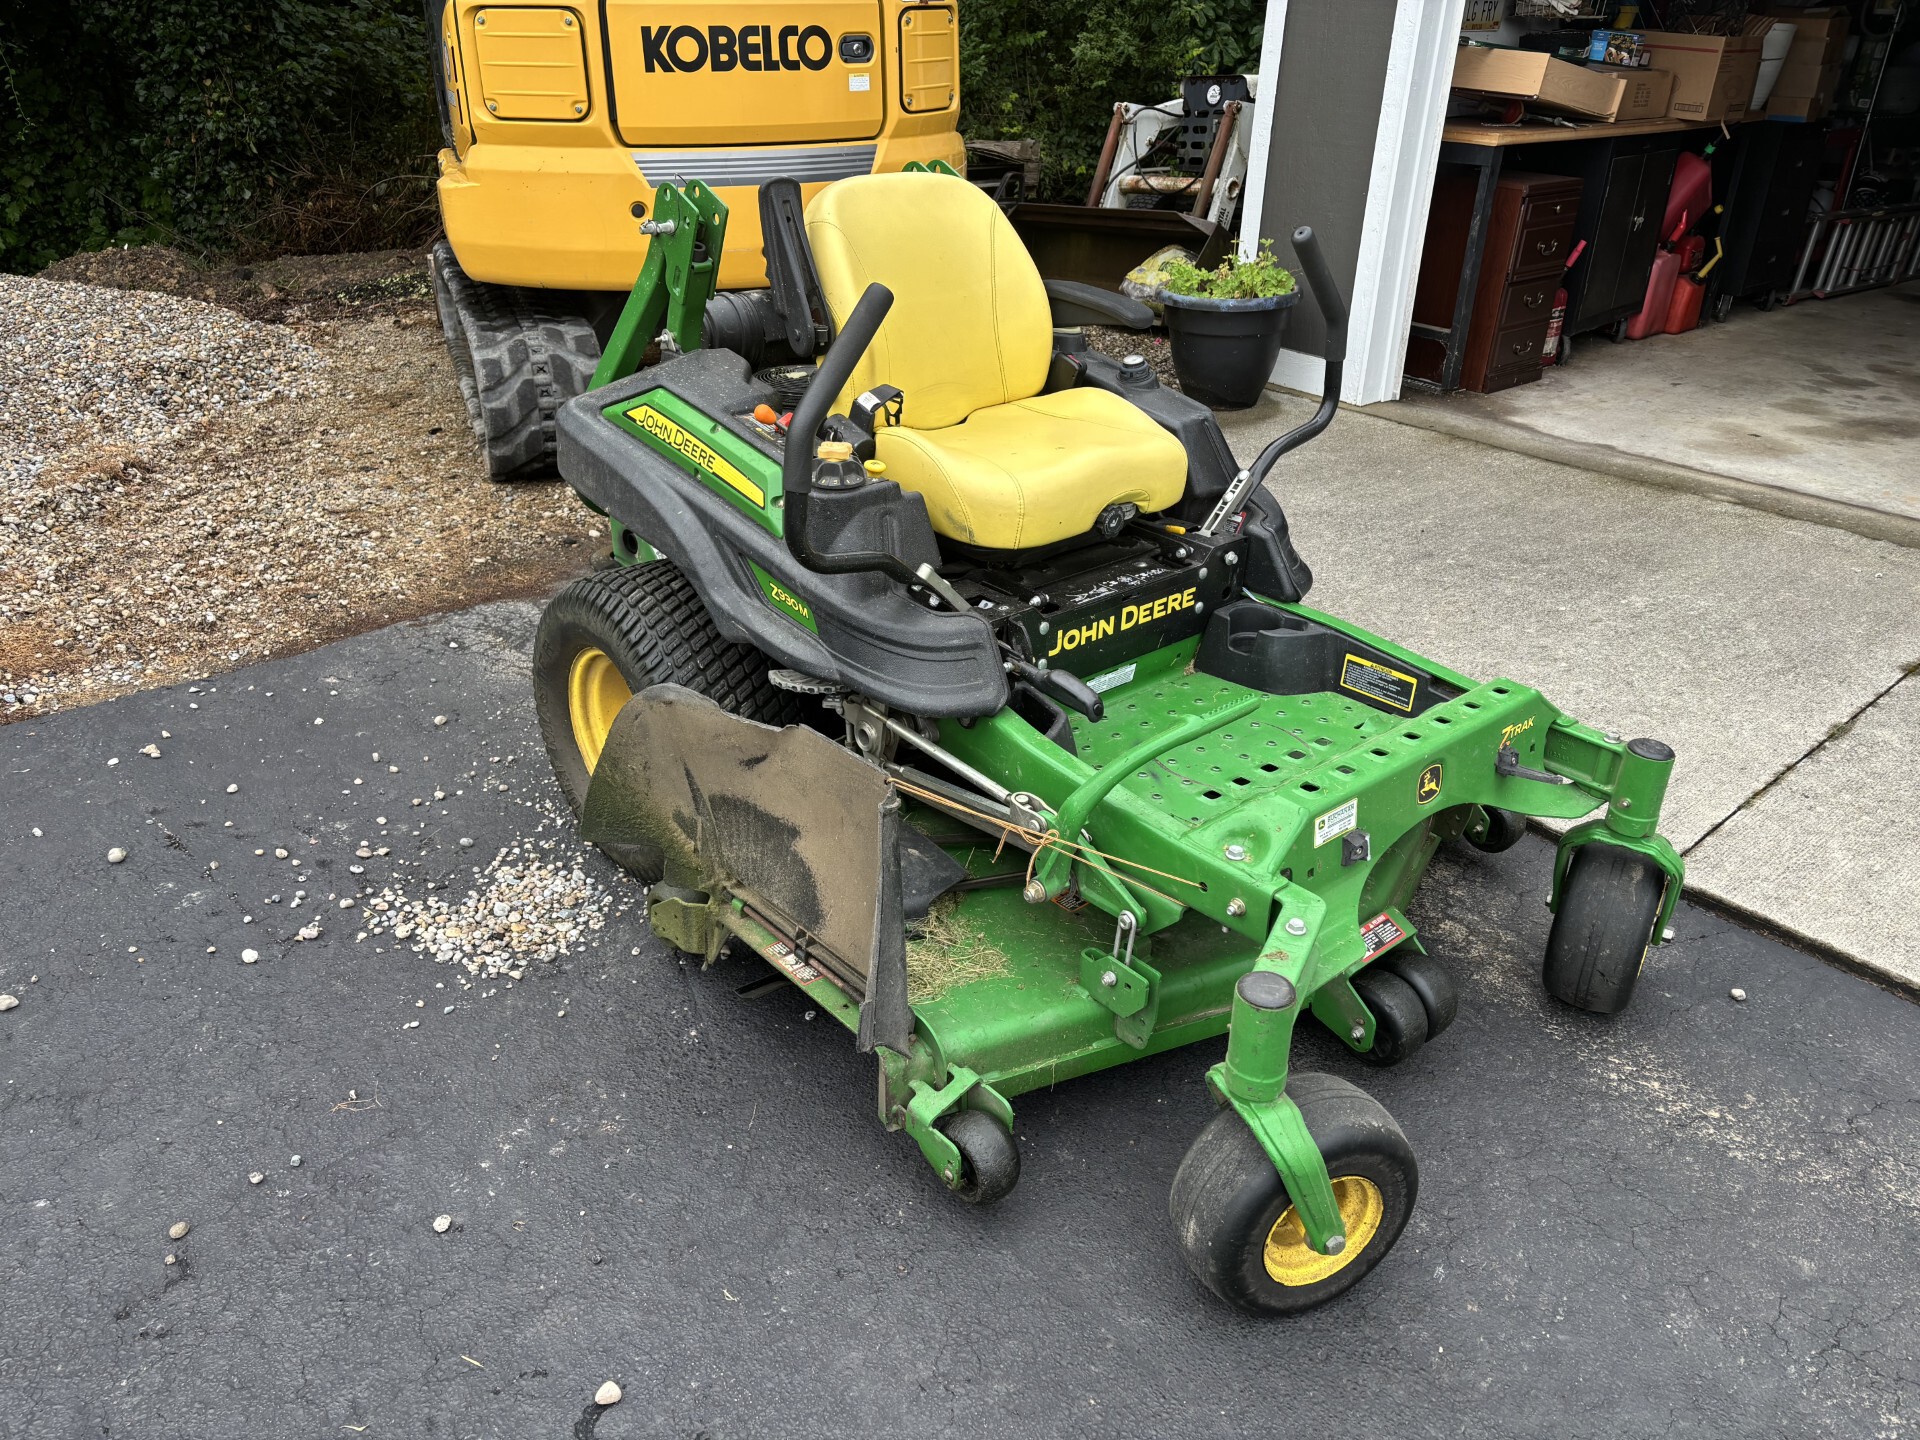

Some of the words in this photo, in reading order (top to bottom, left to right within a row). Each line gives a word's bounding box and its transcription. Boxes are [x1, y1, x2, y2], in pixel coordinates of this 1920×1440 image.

[1481, 1, 1498, 21] FRY
[641, 25, 833, 73] KOBELCO
[638, 409, 672, 441] JOHN
[673, 429, 716, 470] DEERE
[769, 582, 809, 619] Z930M
[1048, 615, 1115, 657] JOHN
[1121, 587, 1197, 631] DEERE
